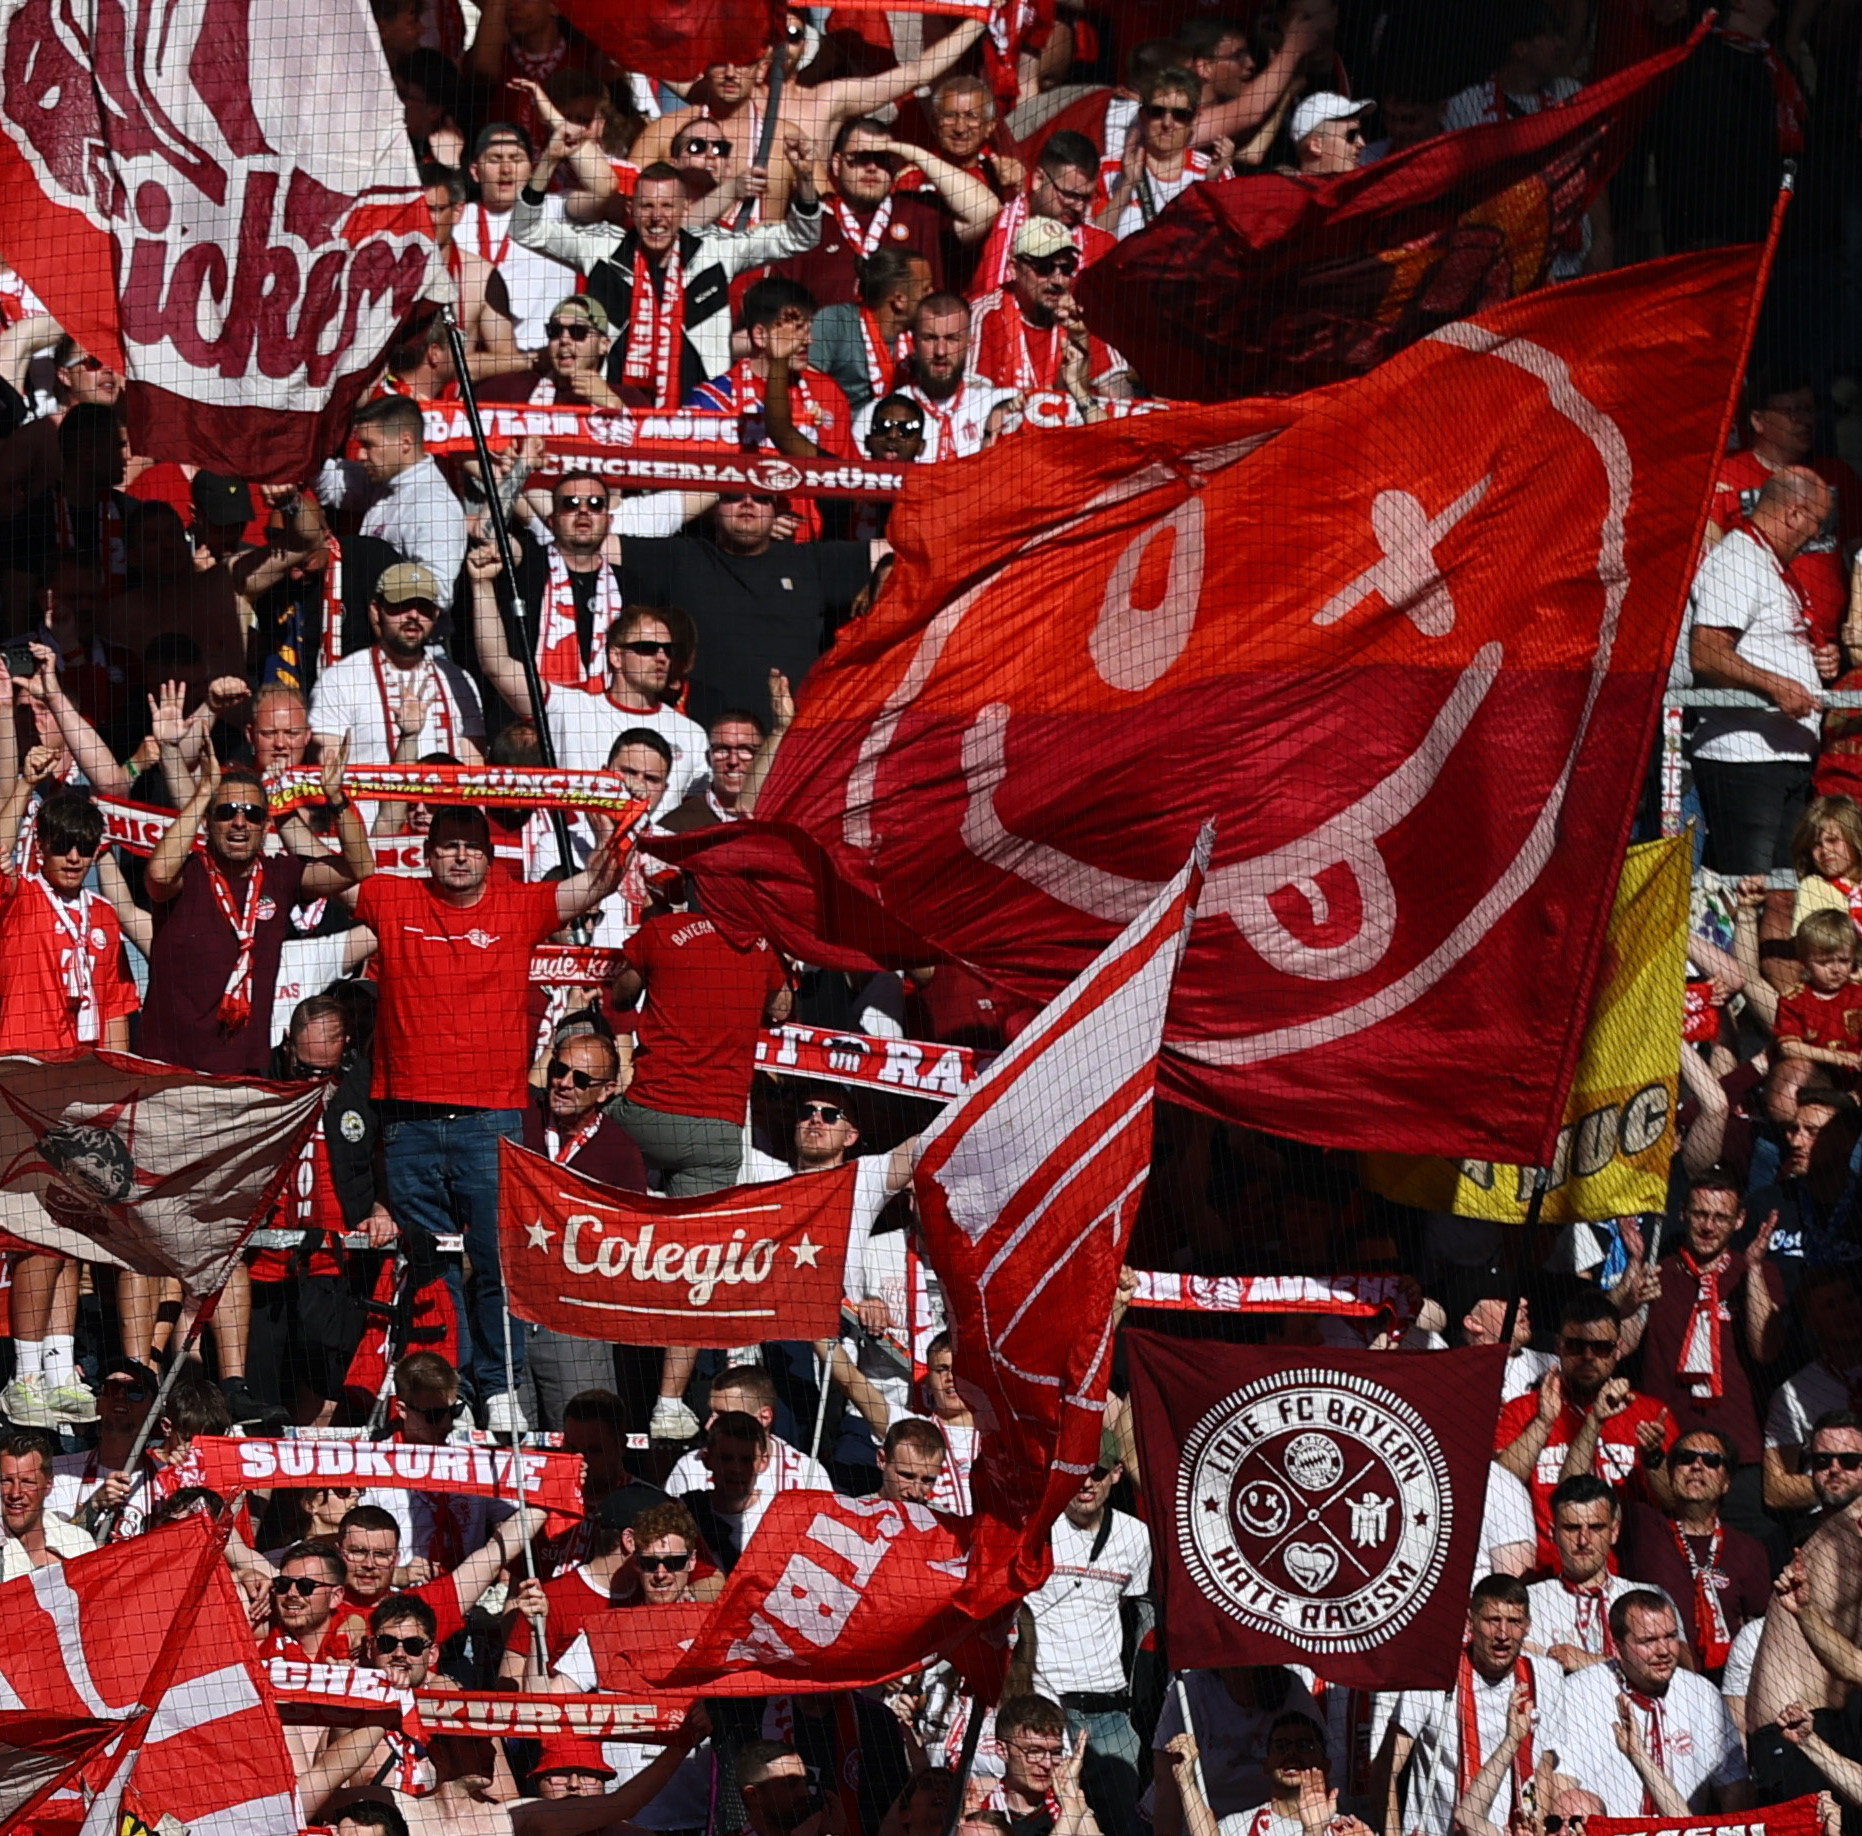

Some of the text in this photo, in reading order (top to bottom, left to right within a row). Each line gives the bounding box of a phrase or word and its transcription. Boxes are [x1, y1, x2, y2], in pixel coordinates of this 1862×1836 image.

[544, 451, 746, 486] CHICKERIA
[563, 1213, 775, 1307] Colegio
[1205, 1396, 1424, 1484] LOVE FC BAYERN
[1210, 1544, 1292, 1622] HATE
[420, 1699, 659, 1737] KURVE
